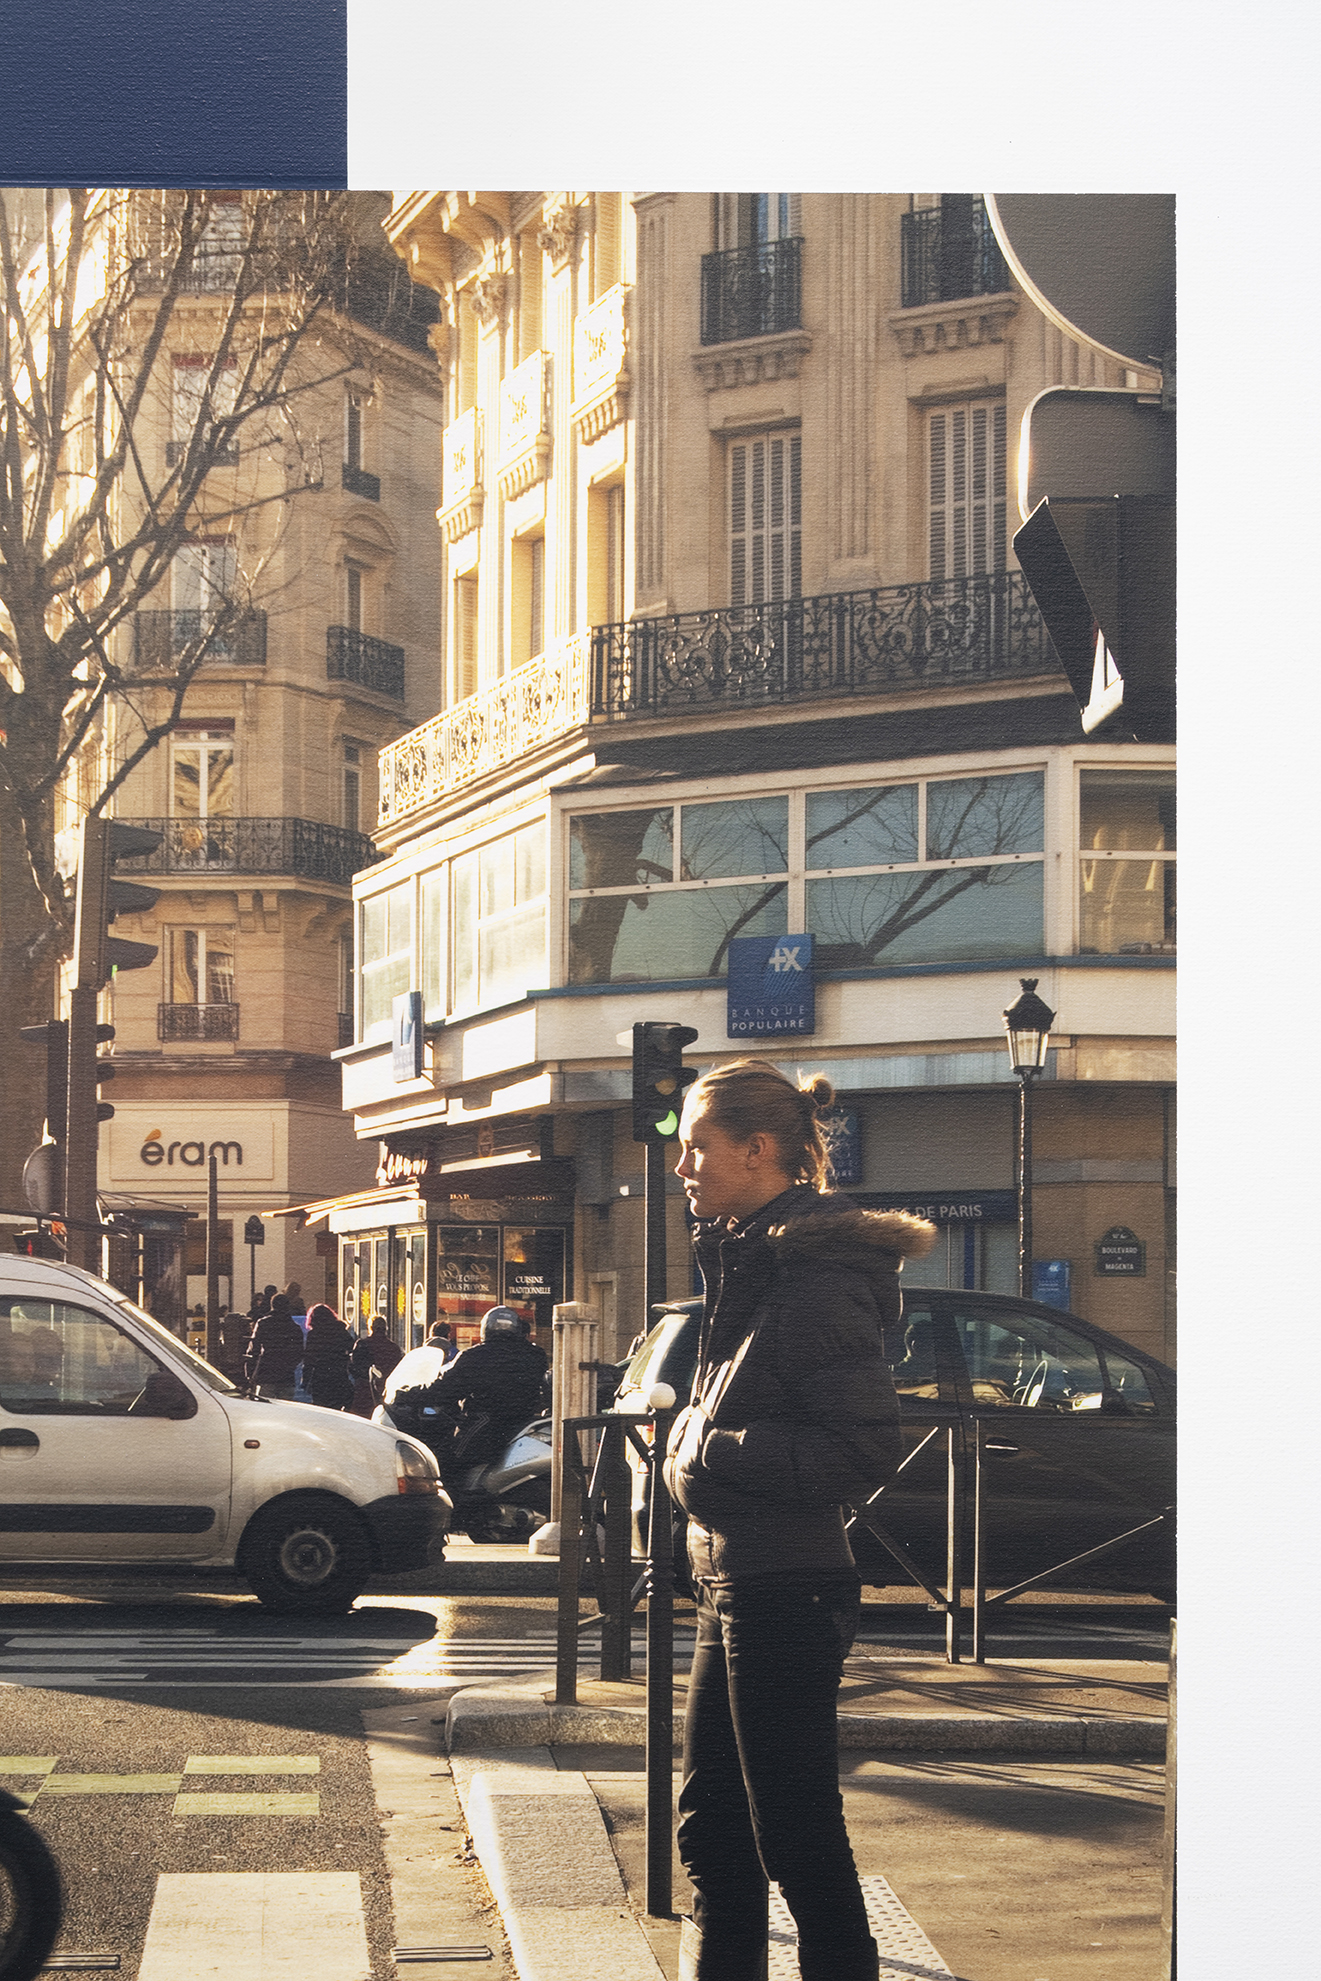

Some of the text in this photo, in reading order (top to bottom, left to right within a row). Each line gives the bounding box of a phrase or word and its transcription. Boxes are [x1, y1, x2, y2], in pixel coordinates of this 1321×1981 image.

[732, 1006, 804, 1018] BANQUE
[732, 1019, 804, 1030] POPULAIRE
[140, 1129, 243, 1166] éram
[915, 1206, 936, 1218] DE
[939, 1204, 983, 1218] PARIS
[515, 1276, 544, 1284] CUISINE
[508, 1287, 551, 1295] TRADITIONNELLE
